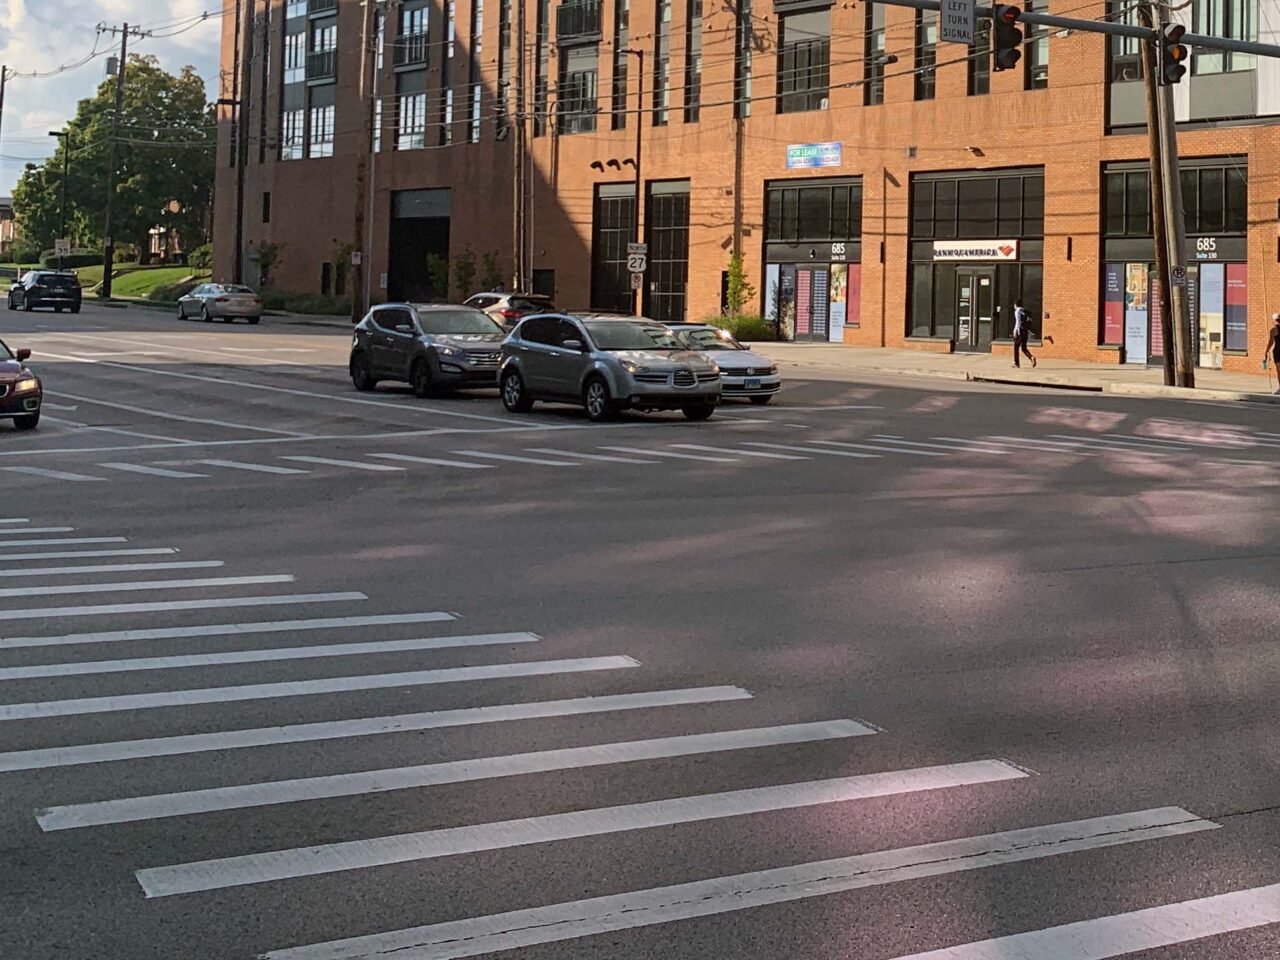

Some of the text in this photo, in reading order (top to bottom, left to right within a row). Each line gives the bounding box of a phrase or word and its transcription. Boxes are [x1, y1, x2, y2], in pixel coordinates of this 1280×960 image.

[947, 1, 967, 12] LEFT
[947, 14, 969, 25] TURN
[943, 27, 972, 40] SIGNAL
[789, 148, 801, 158] FOR
[802, 146, 818, 157] LEASE
[831, 243, 846, 254] 685
[1196, 238, 1217, 251] 685
[630, 257, 645, 269] 27
